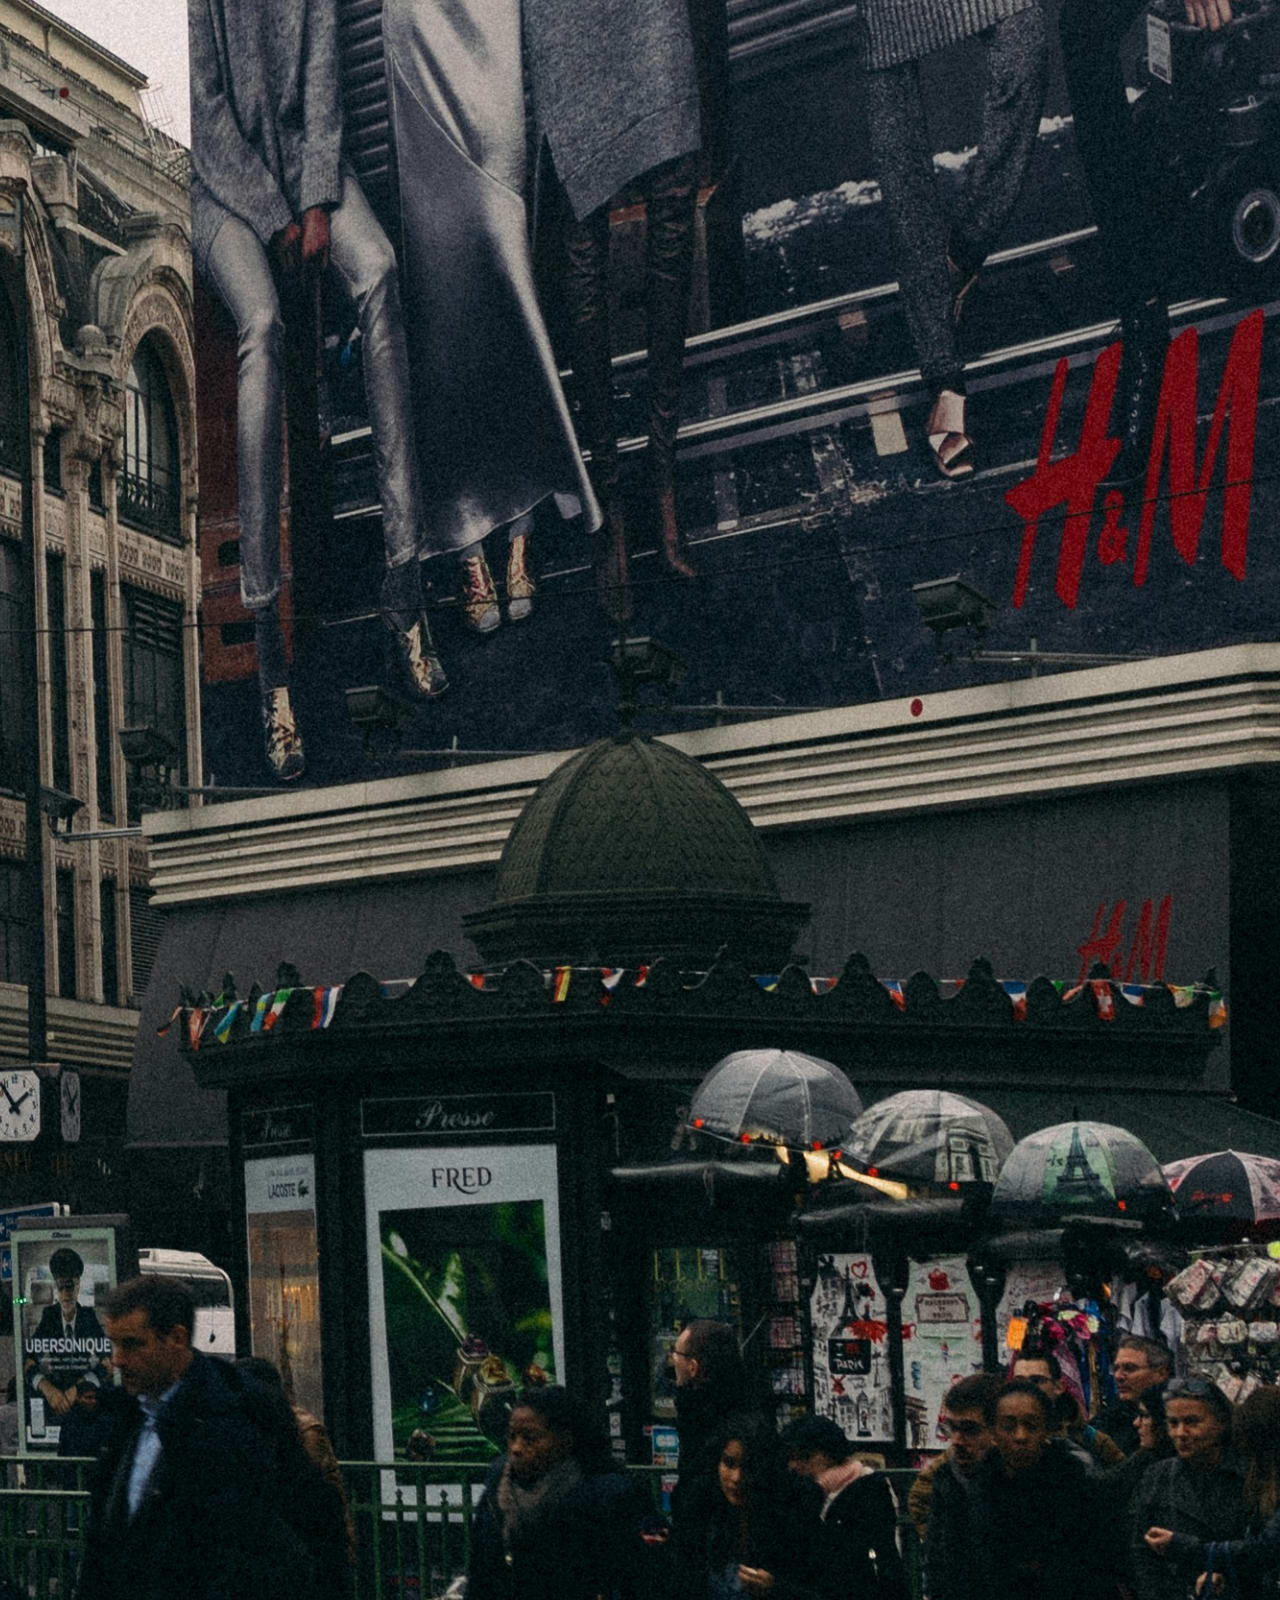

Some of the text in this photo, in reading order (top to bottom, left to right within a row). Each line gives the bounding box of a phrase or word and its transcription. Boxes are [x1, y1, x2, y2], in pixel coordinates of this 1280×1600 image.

[1004, 308, 1265, 610] H&M
[431, 1166, 492, 1195] FRED
[25, 1337, 111, 1355] UBERSONIQUE
